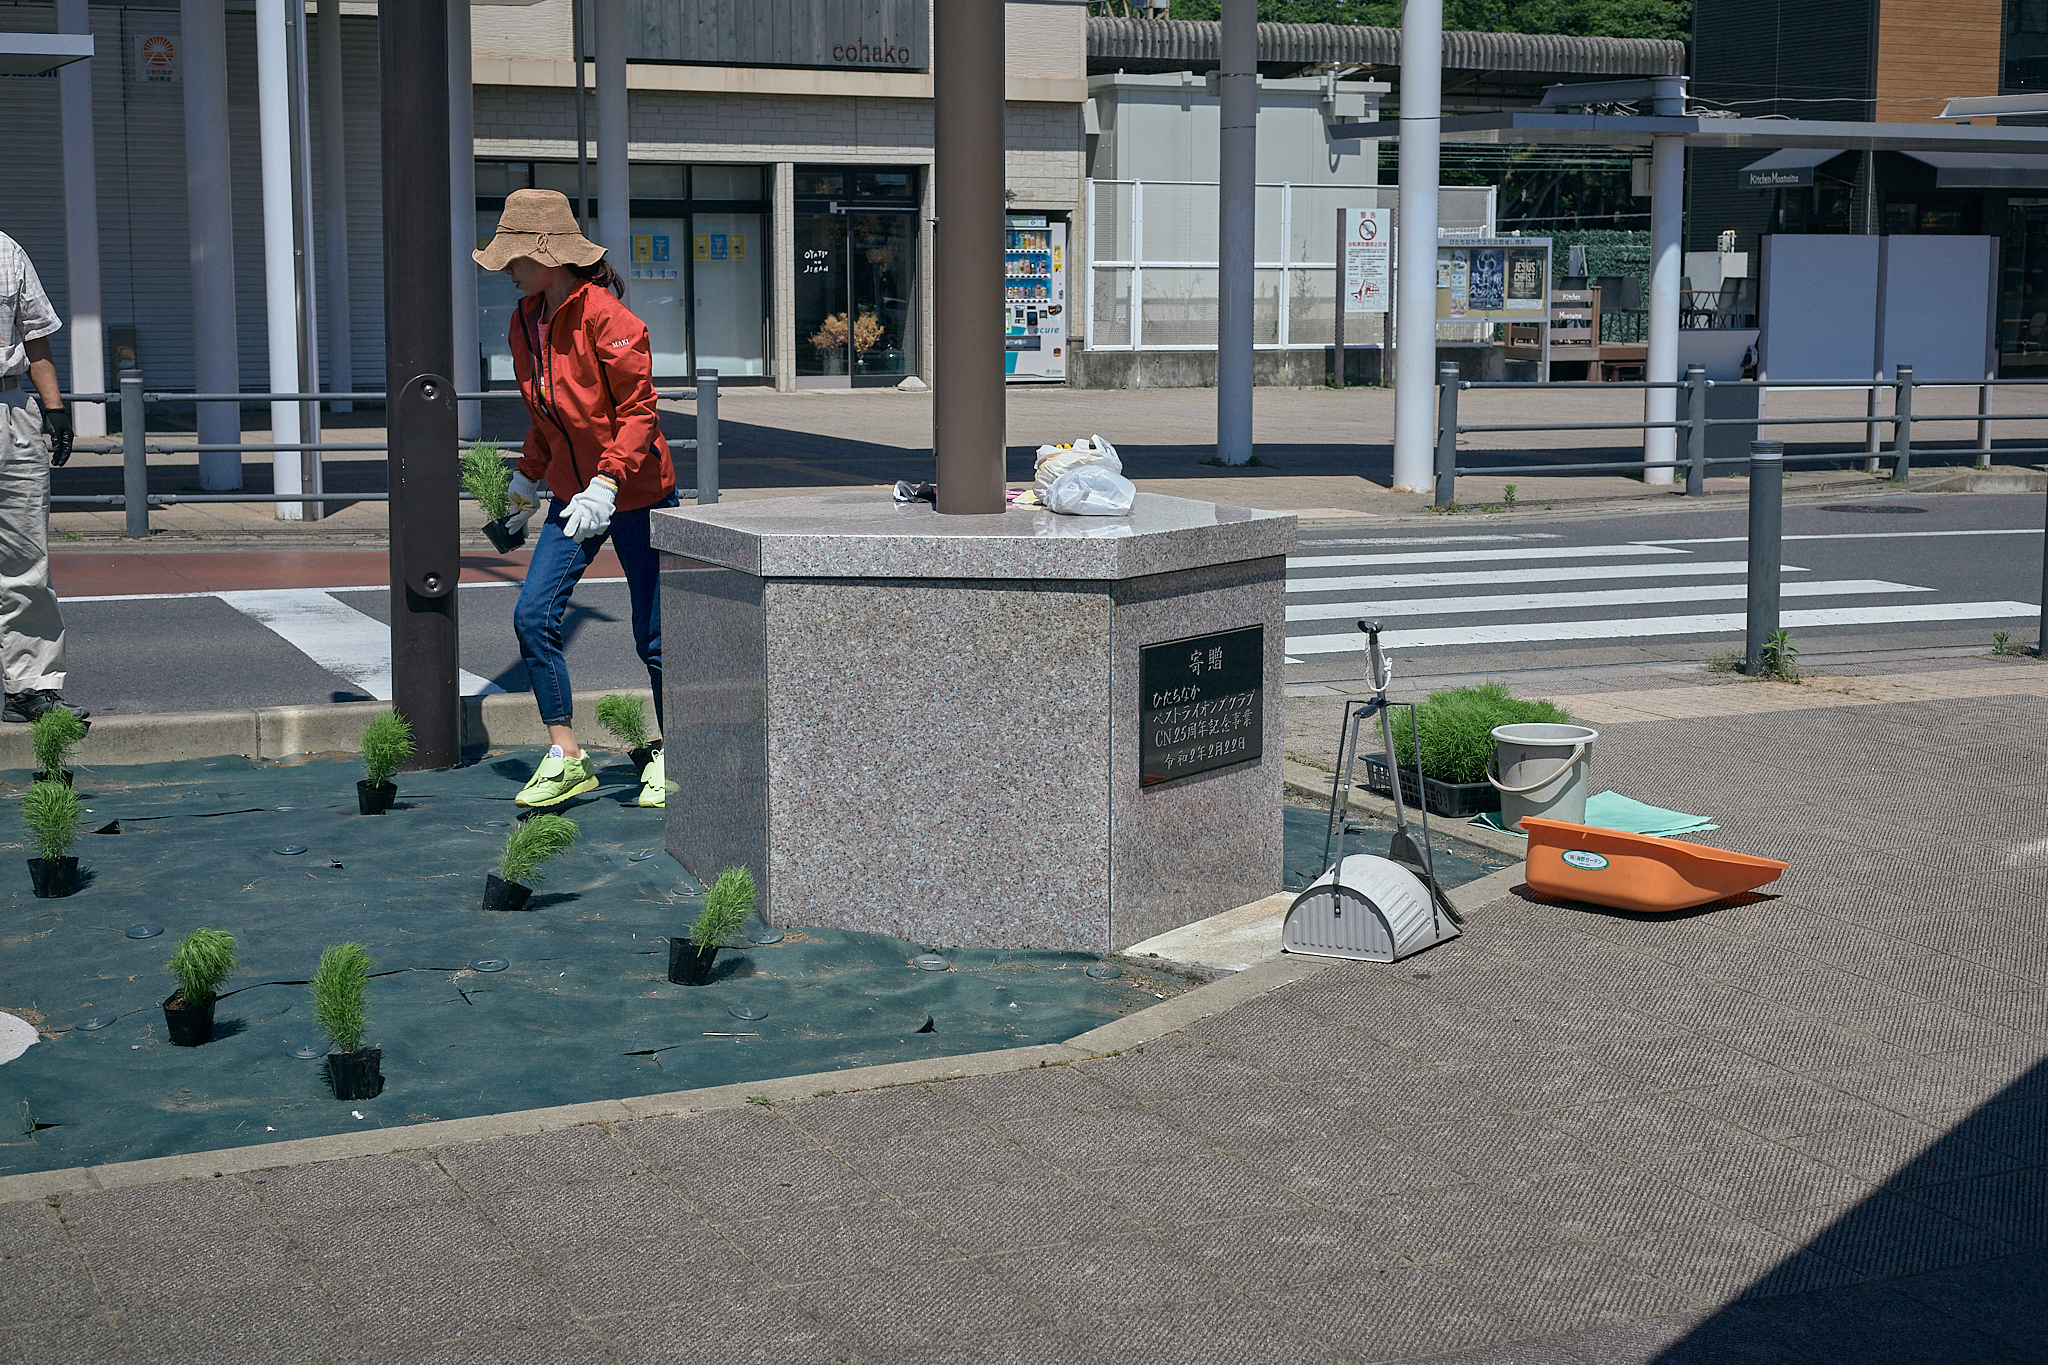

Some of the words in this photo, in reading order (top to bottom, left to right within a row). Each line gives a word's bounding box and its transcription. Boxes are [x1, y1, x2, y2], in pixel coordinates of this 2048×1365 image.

[833, 37, 910, 63] cohako
[1750, 173, 1771, 185] Kitchen
[1514, 261, 1536, 273] JESUS
[1033, 326, 1060, 334] acure
[611, 338, 630, 349] MAKI
[1189, 646, 1223, 676] 寄贈
[1152, 684, 1201, 709] ひたちなか
[1155, 708, 1253, 748] CN25周年記念事業
[1164, 736, 1246, 770] 令和2年2月22日
